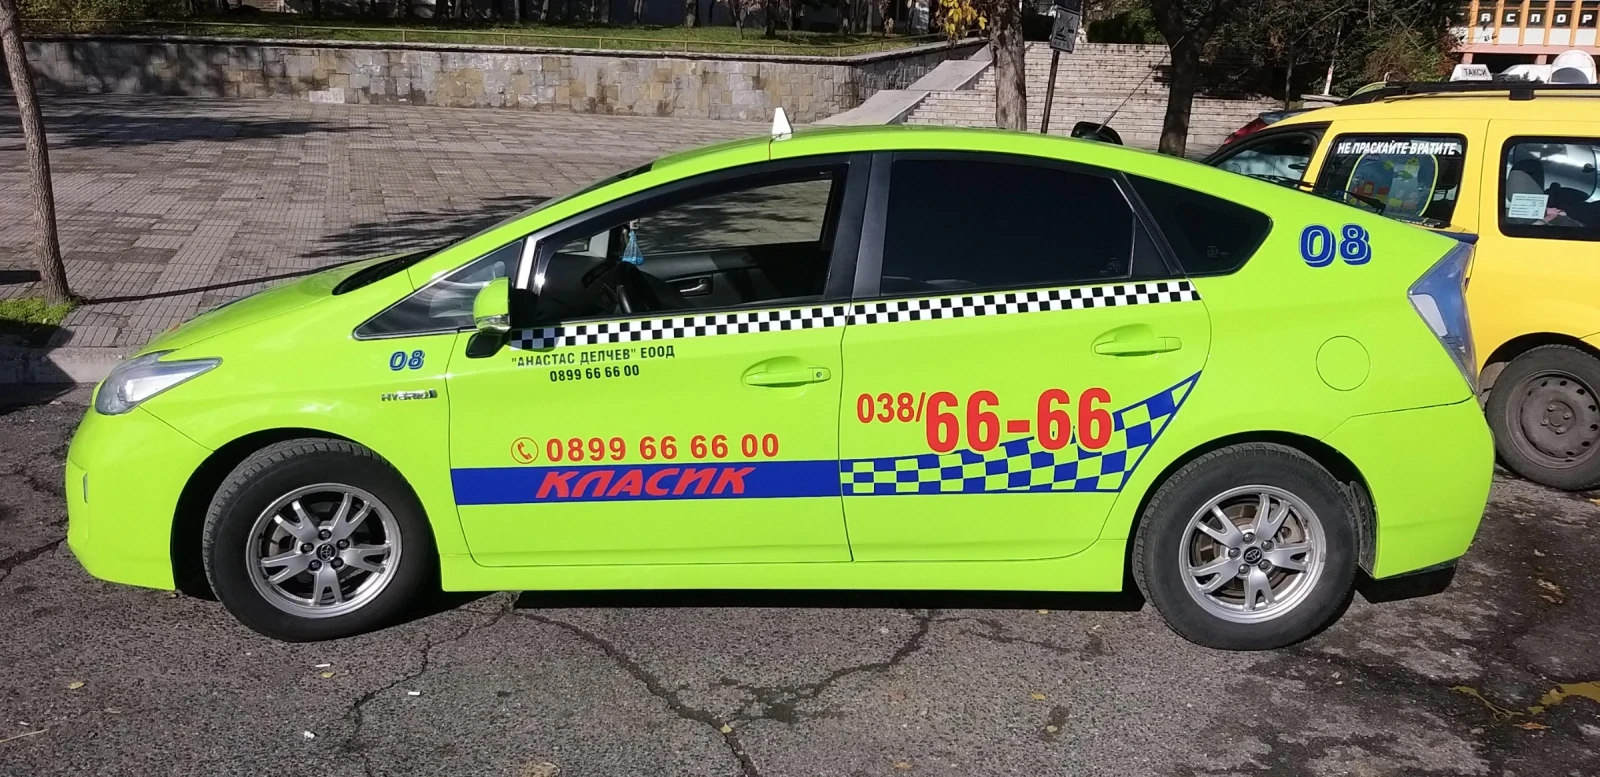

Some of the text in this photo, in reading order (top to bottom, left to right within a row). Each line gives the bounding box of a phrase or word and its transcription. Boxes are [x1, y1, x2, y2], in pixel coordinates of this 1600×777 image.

[1463, 68, 1487, 77] ТАКСИ
[1337, 140, 1458, 155] НЕ ПРАСКАЙТЕ ВРАТИТЕ
[1300, 224, 1372, 267] 08
[389, 350, 426, 371] 08
[511, 345, 676, 368] "АНАСТАС ДЕЛЧЕВ" ЕООД
[549, 364, 640, 383] 0899 66 66 00
[546, 433, 779, 462] 0899 66 66 00
[535, 467, 756, 498] КЛАСИК
